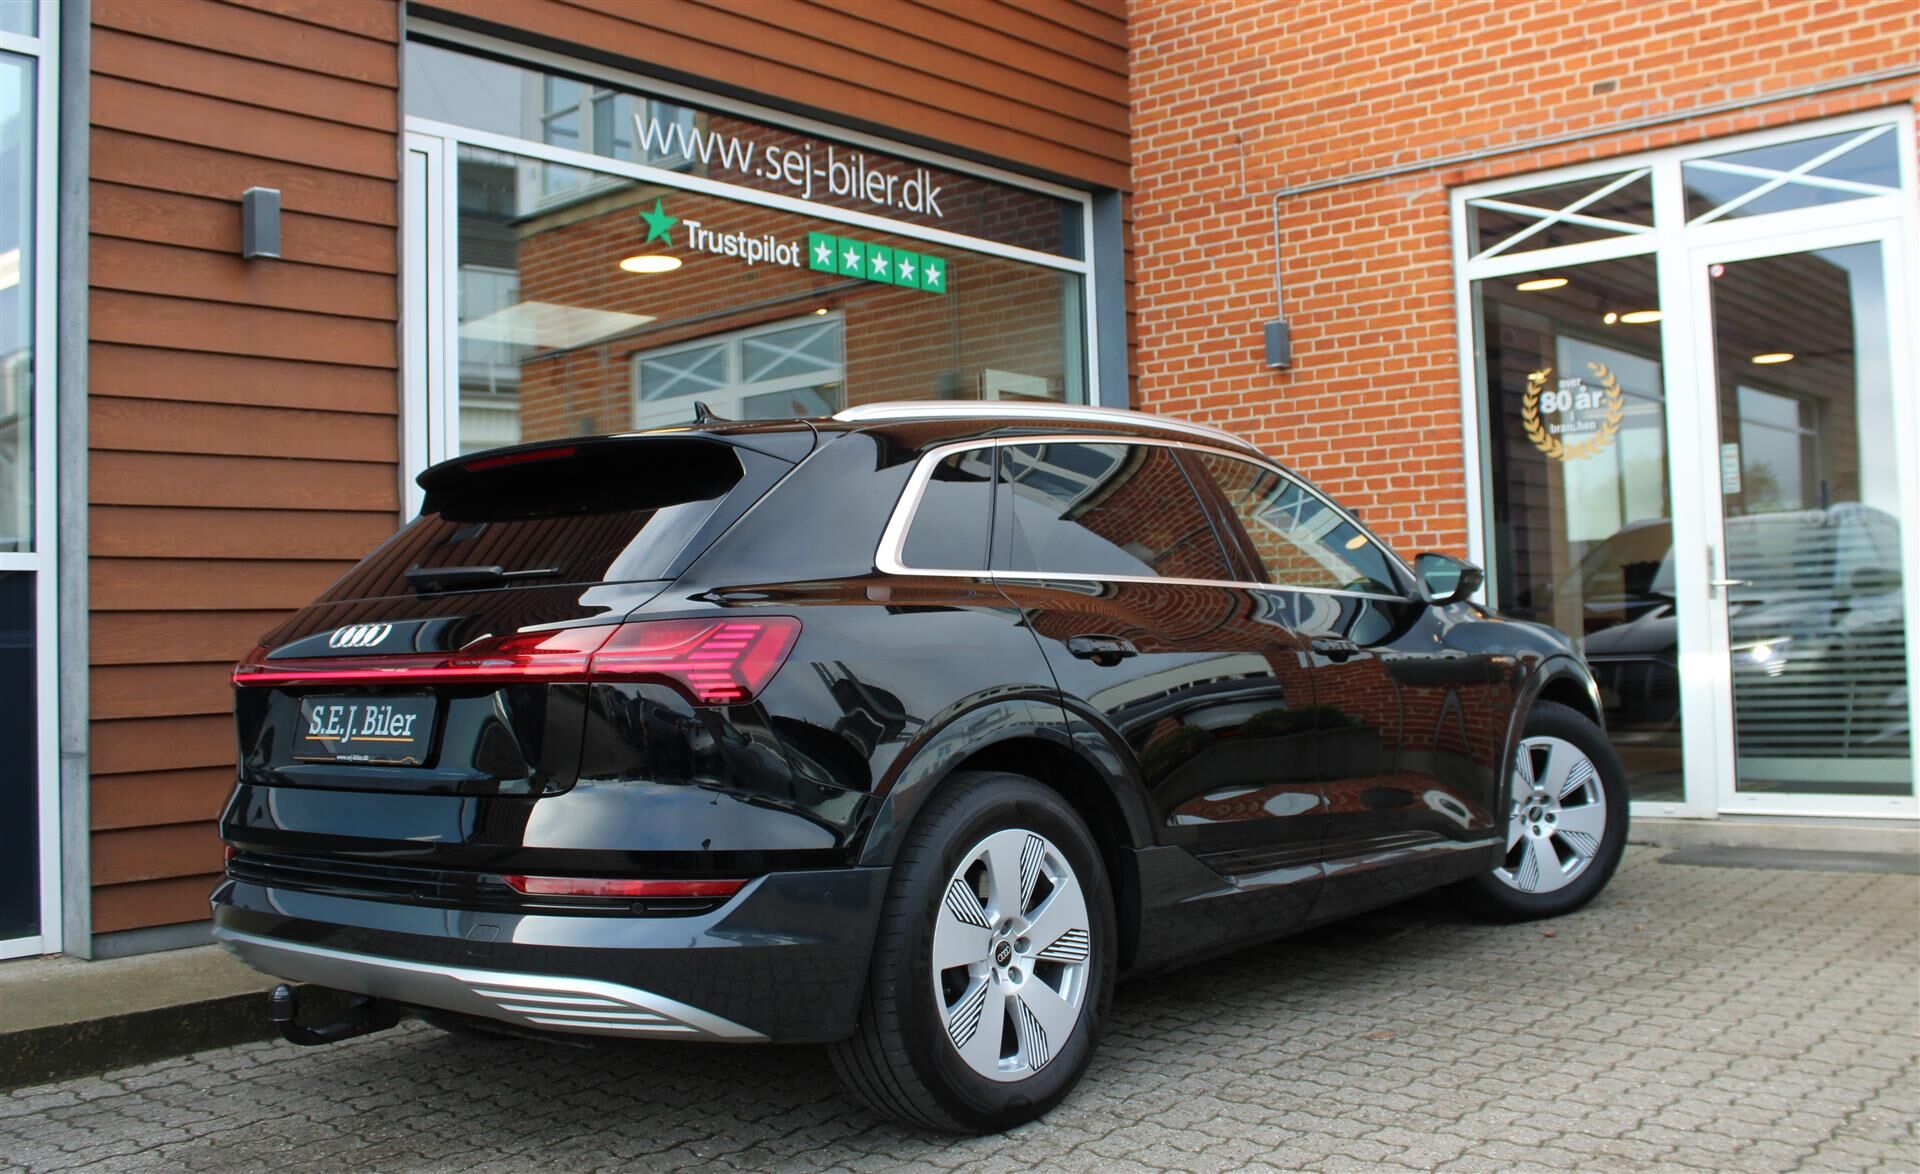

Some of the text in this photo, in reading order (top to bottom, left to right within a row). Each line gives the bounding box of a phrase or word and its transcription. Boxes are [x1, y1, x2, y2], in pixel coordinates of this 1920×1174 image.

[634, 113, 943, 217] www.sej-biler.dk
[683, 219, 800, 267] Trustpilot
[1540, 385, 1602, 413] 80 år
[1559, 378, 1581, 388] over
[309, 705, 417, 743] S.E.J. Biler
